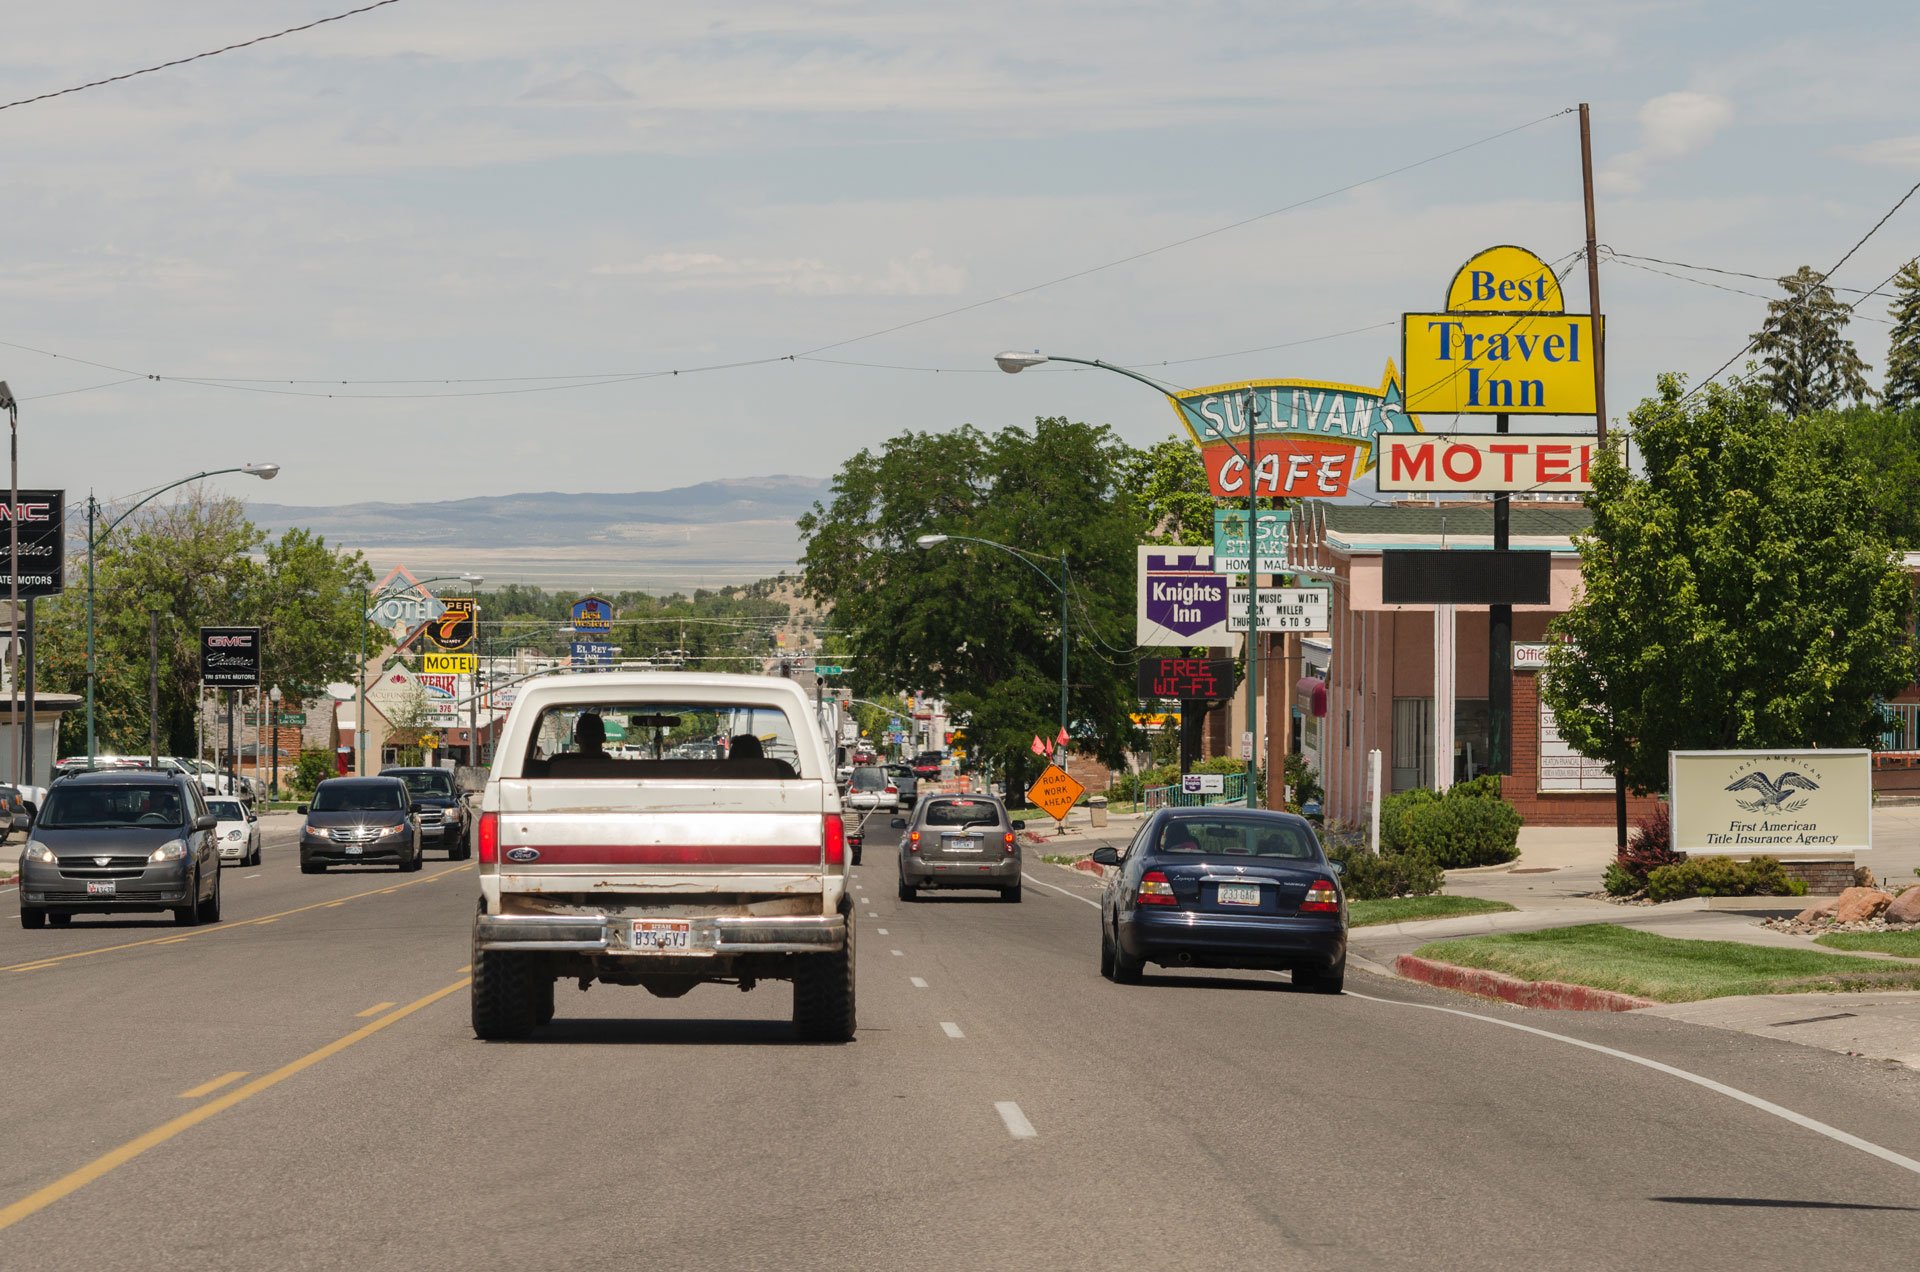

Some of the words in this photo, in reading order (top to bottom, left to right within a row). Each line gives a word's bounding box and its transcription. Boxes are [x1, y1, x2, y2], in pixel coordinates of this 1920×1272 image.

[1469, 270, 1548, 301] Best
[1428, 321, 1581, 363] Travel
[1465, 368, 1545, 407] Inn
[1200, 389, 1402, 438] SULLIVAN'S
[1219, 453, 1347, 493] CAFE
[1225, 559, 1252, 570] HOM
[18, 576, 52, 585] MOTORS
[1153, 582, 1222, 605] Knights
[1232, 593, 1250, 603] LIVE
[1258, 593, 1282, 603] MUSIC
[1298, 593, 1319, 603] WITH
[444, 602, 472, 612] PER
[1173, 604, 1201, 622] Inn
[1276, 605, 1304, 615] MILLER
[581, 610, 601, 619] Best
[574, 618, 610, 628] Western
[1232, 617, 1271, 626] THURDAY
[1280, 617, 1287, 626] 6
[1290, 617, 1299, 626] TO
[1304, 617, 1311, 626] 9
[208, 635, 252, 647] GMC
[1516, 648, 1546, 661] Offic
[426, 656, 474, 670] MOTEL
[1160, 659, 1212, 677] FREE
[419, 675, 456, 698] VERIK
[1153, 677, 1217, 696] WI-FI
[1729, 758, 1758, 780] FIRST
[1766, 755, 1822, 780] AMERICAN
[1042, 774, 1066, 785] ROAD
[1044, 785, 1068, 796] WORK
[1044, 796, 1072, 806] AHEAD
[1729, 820, 1757, 832] First
[1759, 820, 1817, 832] American
[1706, 833, 1733, 844] Title
[1735, 833, 1793, 844] Insurance
[1795, 833, 1838, 845] Agency
[513, 850, 533, 859] Ford
